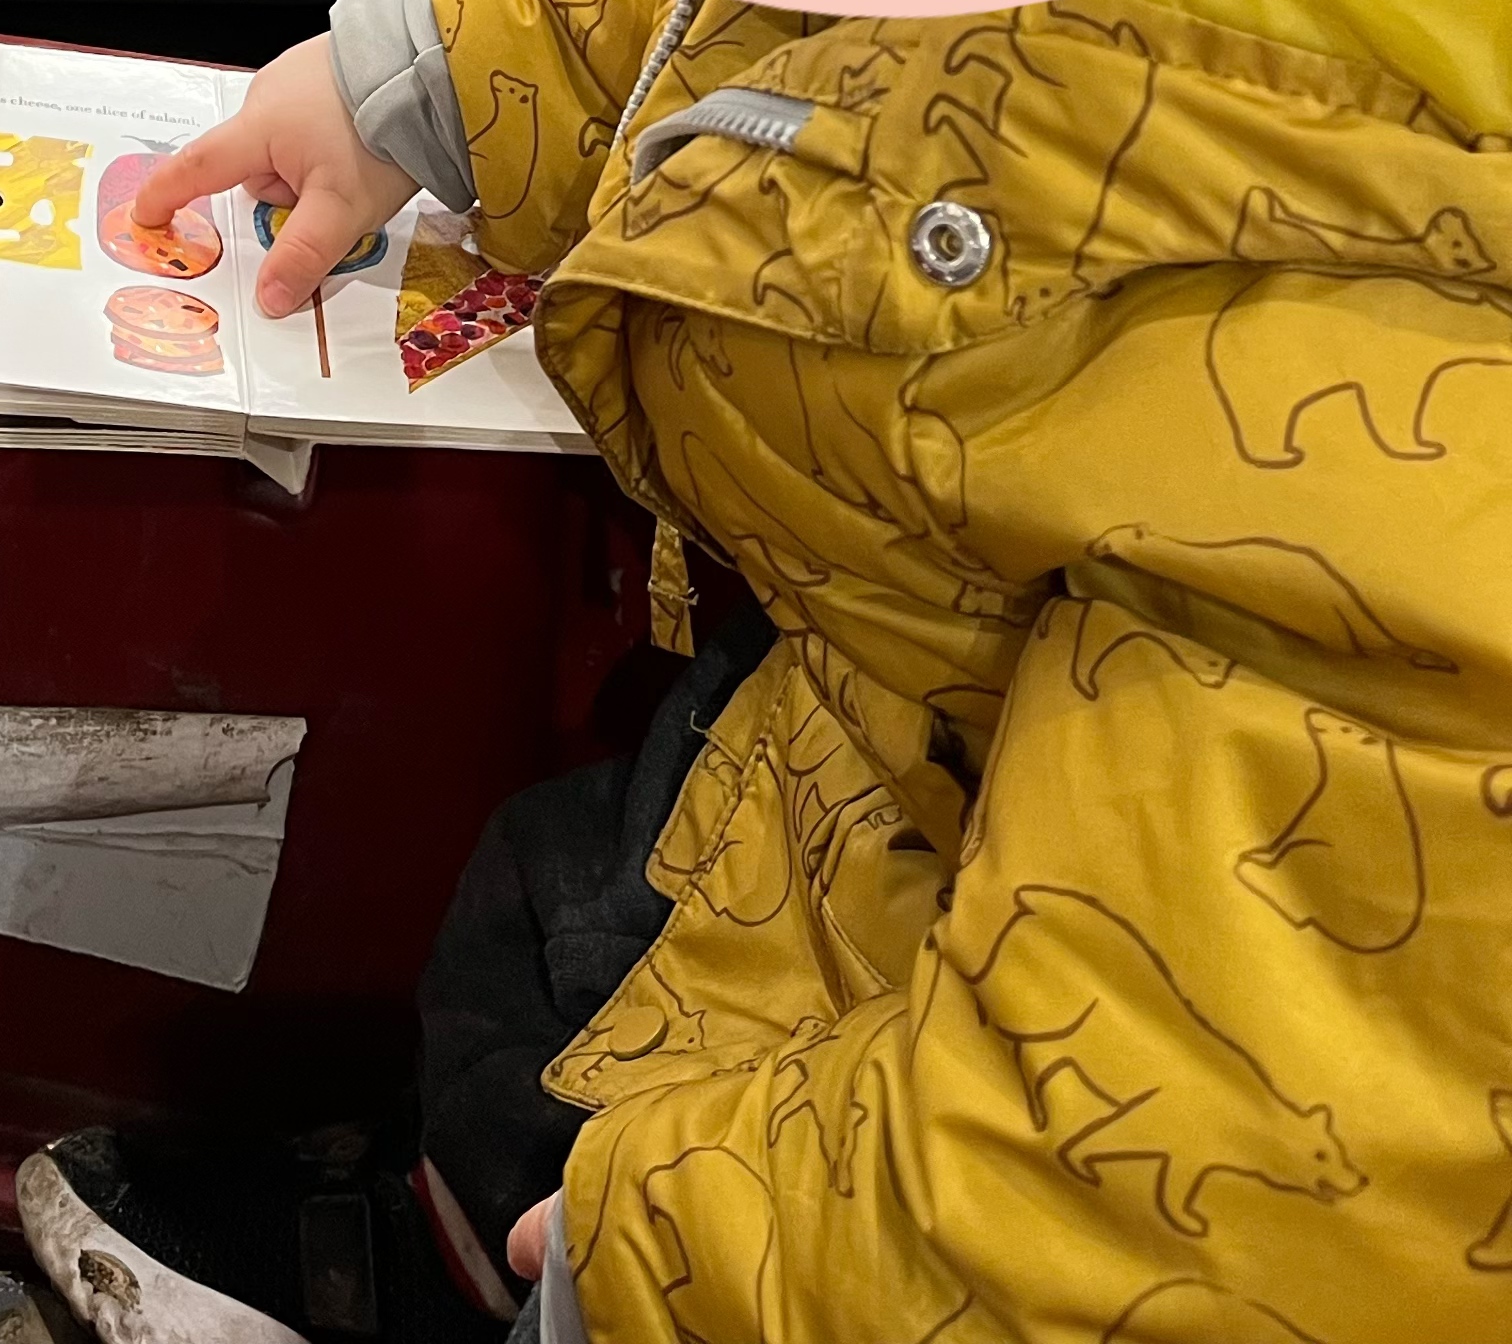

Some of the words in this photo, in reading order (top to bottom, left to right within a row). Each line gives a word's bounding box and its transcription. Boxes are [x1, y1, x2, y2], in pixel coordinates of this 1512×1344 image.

[10, 96, 62, 111] cheese,
[65, 104, 92, 113] one
[95, 105, 128, 118] slice
[131, 109, 146, 120] of
[149, 112, 201, 127] salami.
